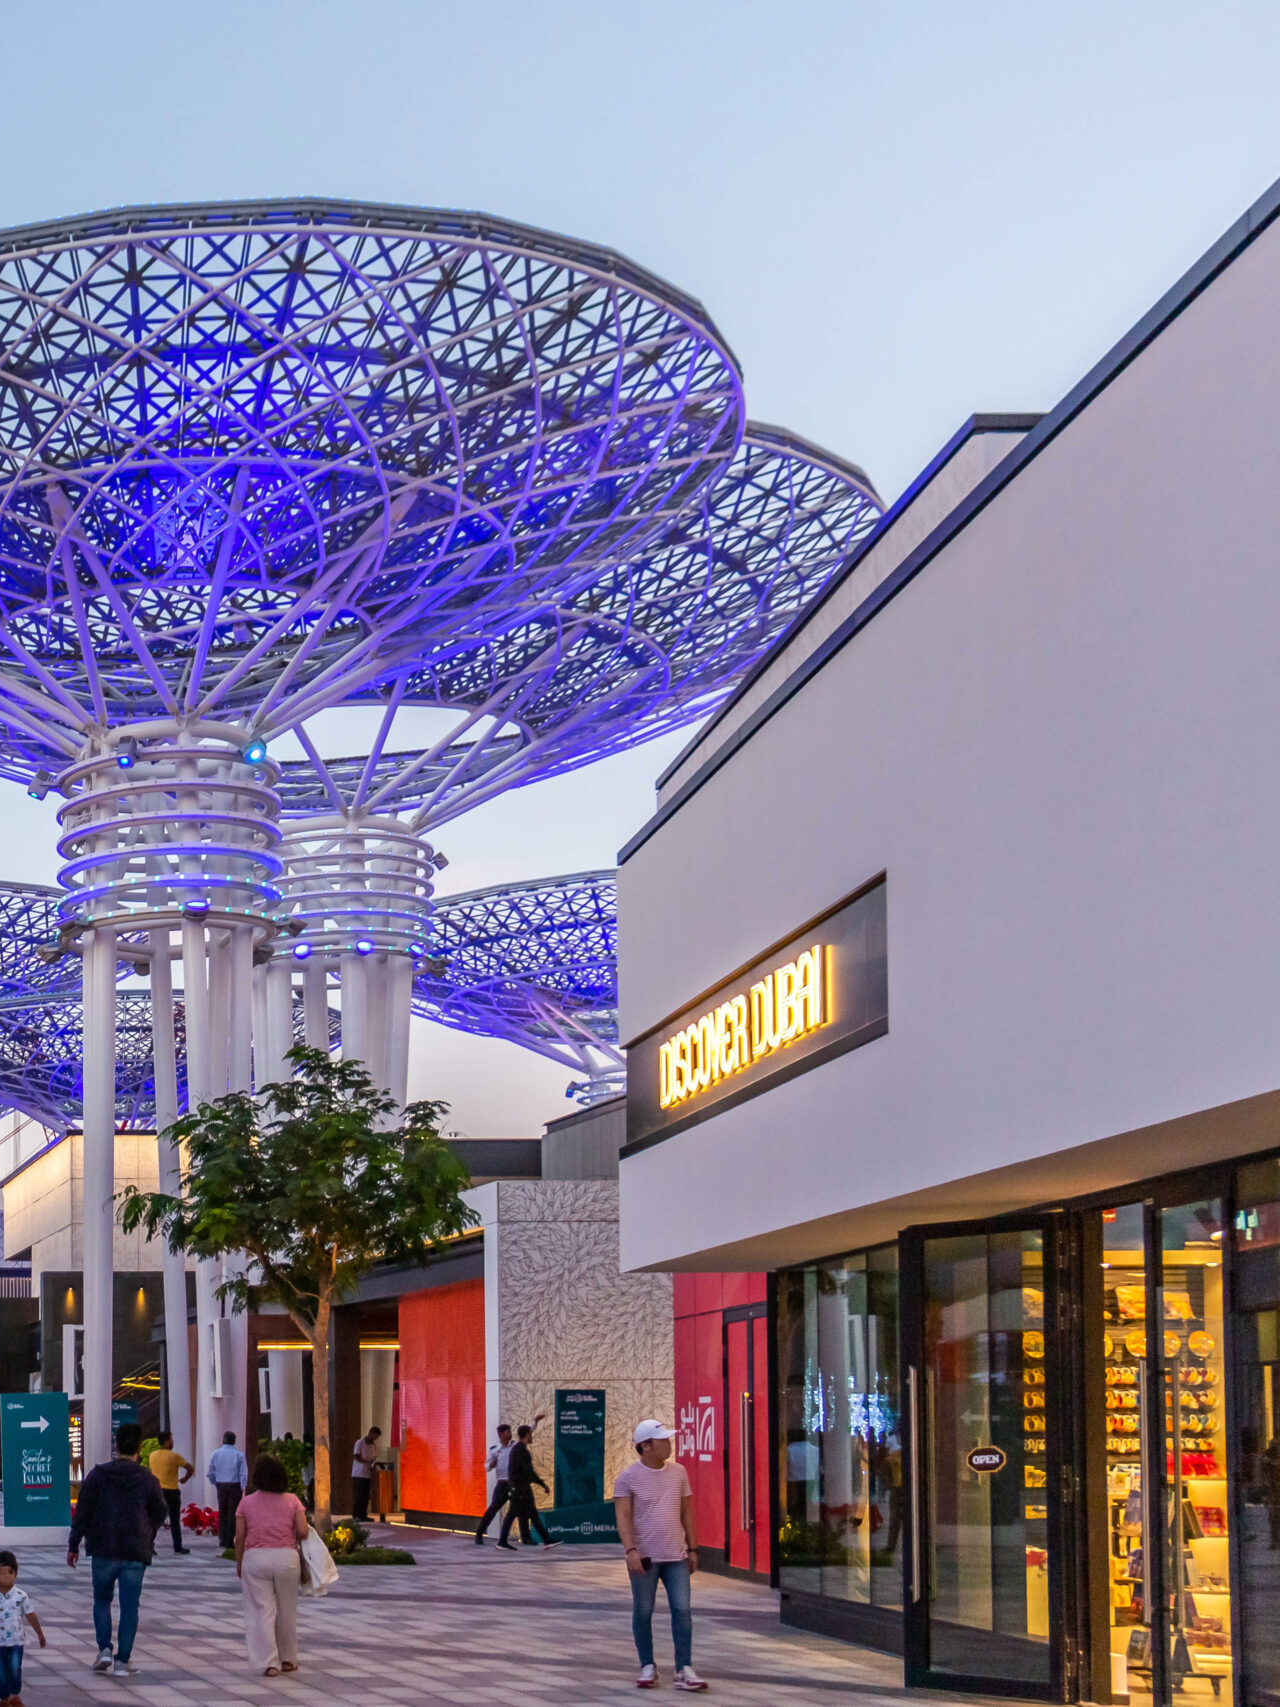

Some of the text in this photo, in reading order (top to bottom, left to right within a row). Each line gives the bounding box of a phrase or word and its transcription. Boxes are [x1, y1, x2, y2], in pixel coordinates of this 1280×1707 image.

[659, 943, 833, 1110] DISCOVER DUBAI
[972, 1454, 999, 1464] OPEN
[22, 1461, 51, 1472] SECRET
[23, 1471, 52, 1484] ISLAND
